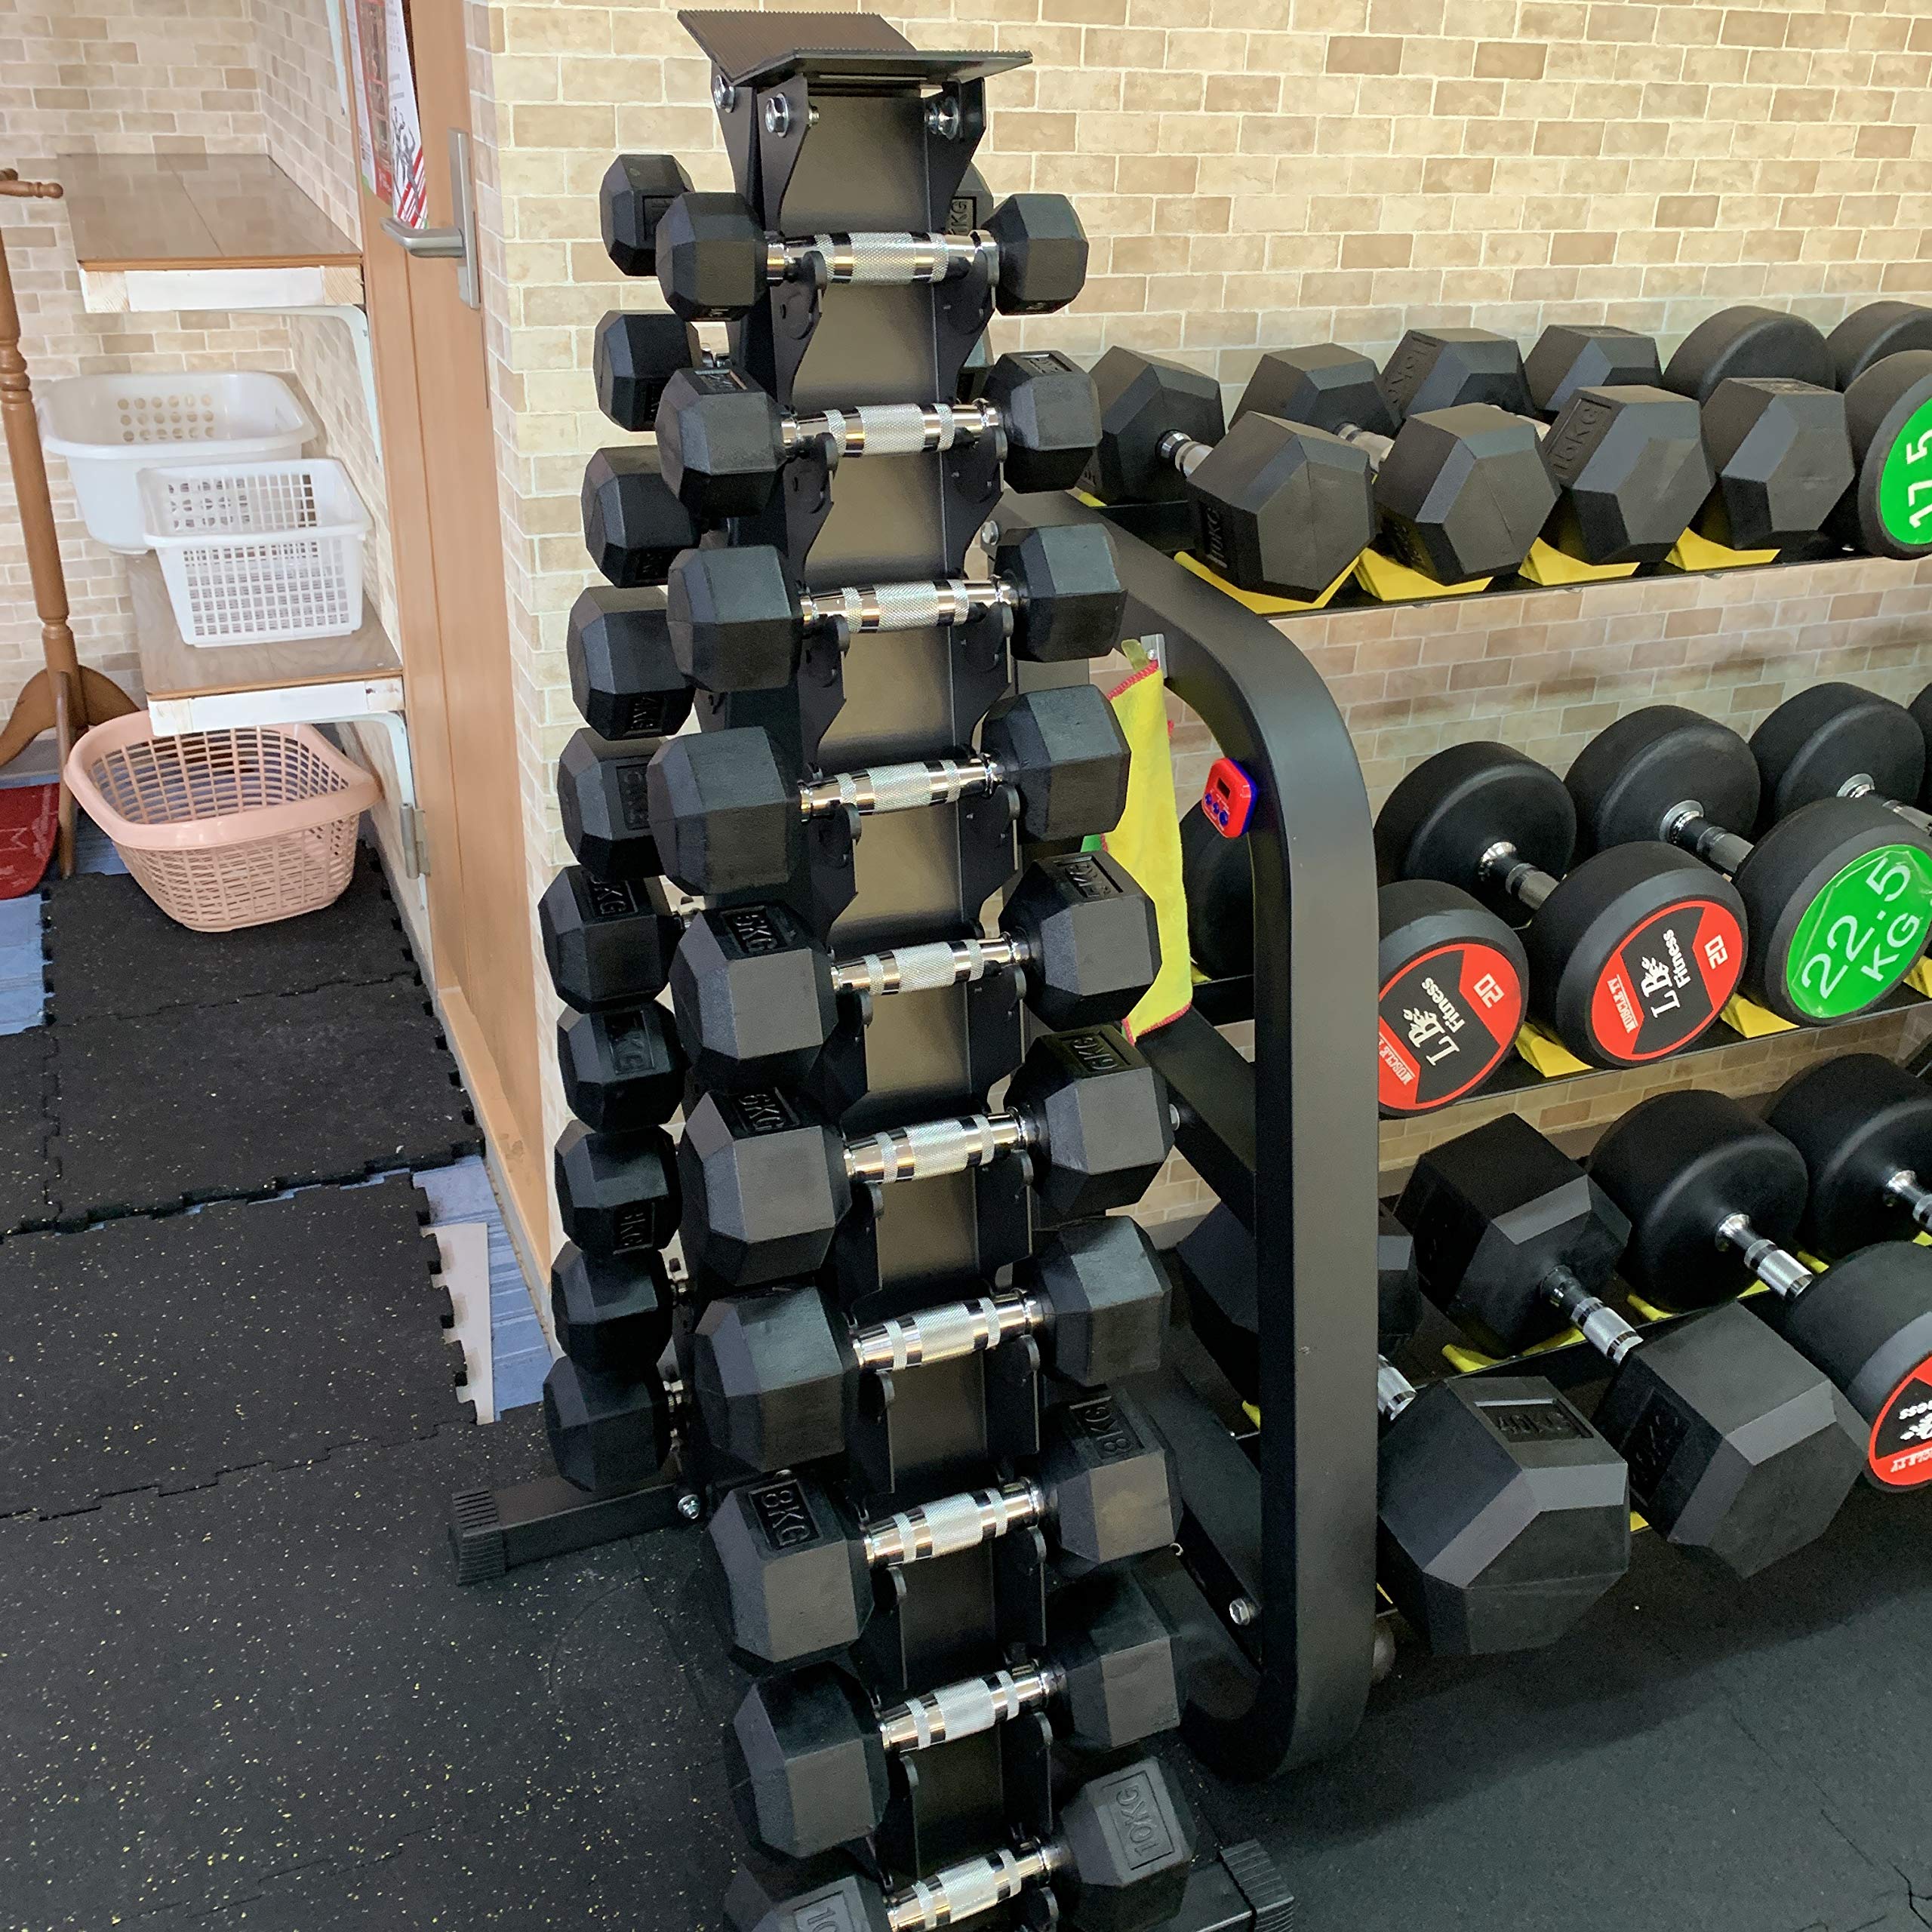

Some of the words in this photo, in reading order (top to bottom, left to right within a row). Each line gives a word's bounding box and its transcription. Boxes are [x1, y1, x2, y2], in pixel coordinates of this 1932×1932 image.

[1704, 935, 1728, 970] 20
[1801, 857, 1911, 999] 22.5
[1860, 912, 1921, 982] KG
[1663, 929, 1691, 989] Fitness
[1421, 977, 1466, 1033] Fitness
[1473, 973, 1504, 1008] 20
[1613, 990, 1636, 1034] MUSCLE
[1084, 1405, 1132, 1453] 8KG
[761, 1490, 810, 1546] 8KG
[1115, 1785, 1160, 1857] 10KG
